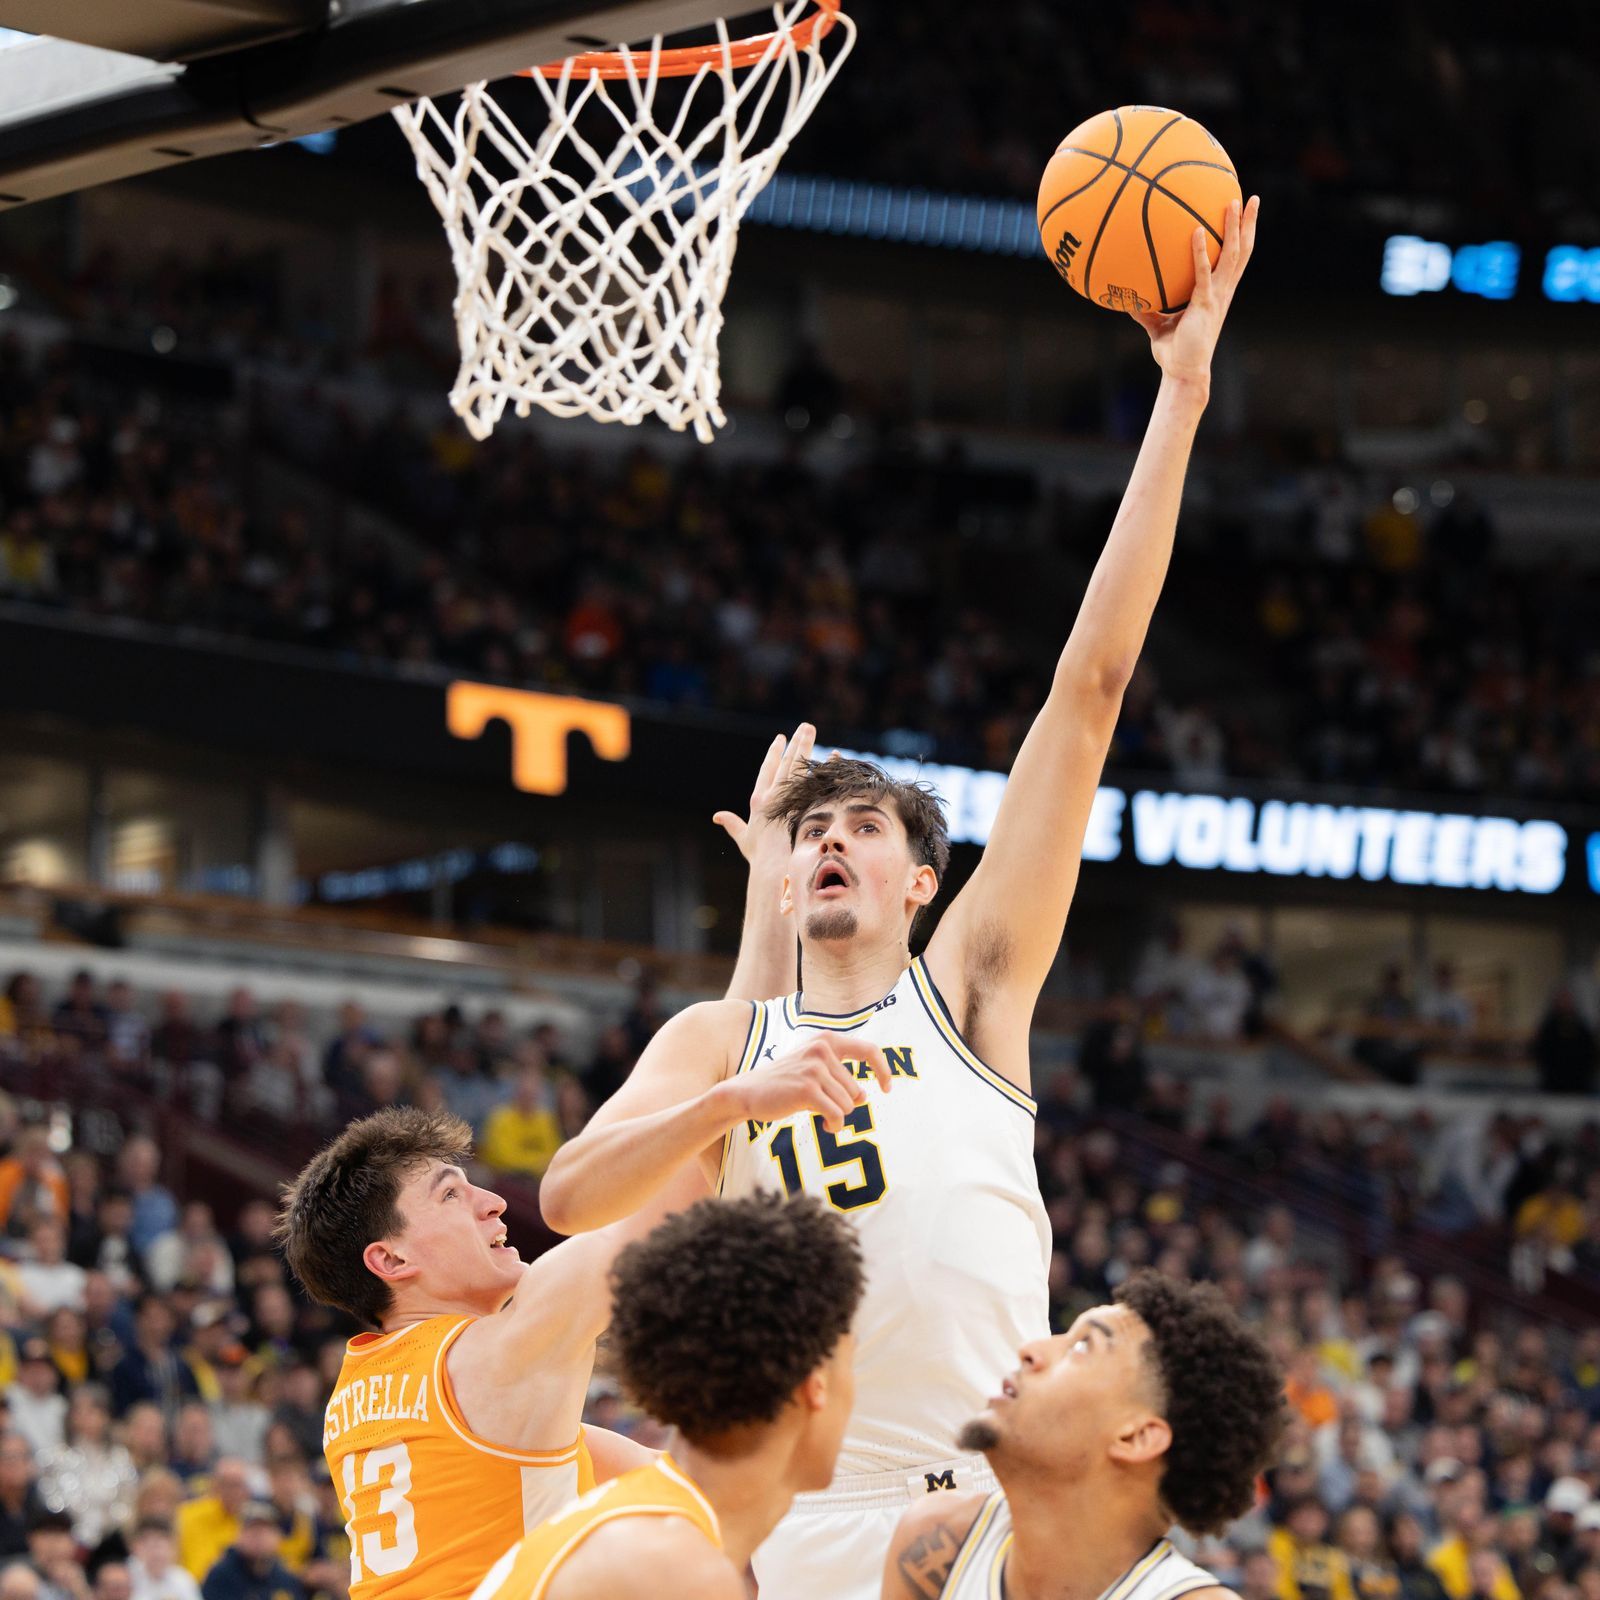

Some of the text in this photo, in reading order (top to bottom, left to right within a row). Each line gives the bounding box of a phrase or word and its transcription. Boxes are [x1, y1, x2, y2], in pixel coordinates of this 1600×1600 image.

[446, 680, 631, 797] T
[1132, 790, 1567, 893] VOLUNTEERS
[768, 1103, 888, 1213] 15
[342, 1441, 419, 1585] 13
[924, 1469, 957, 1493] M
